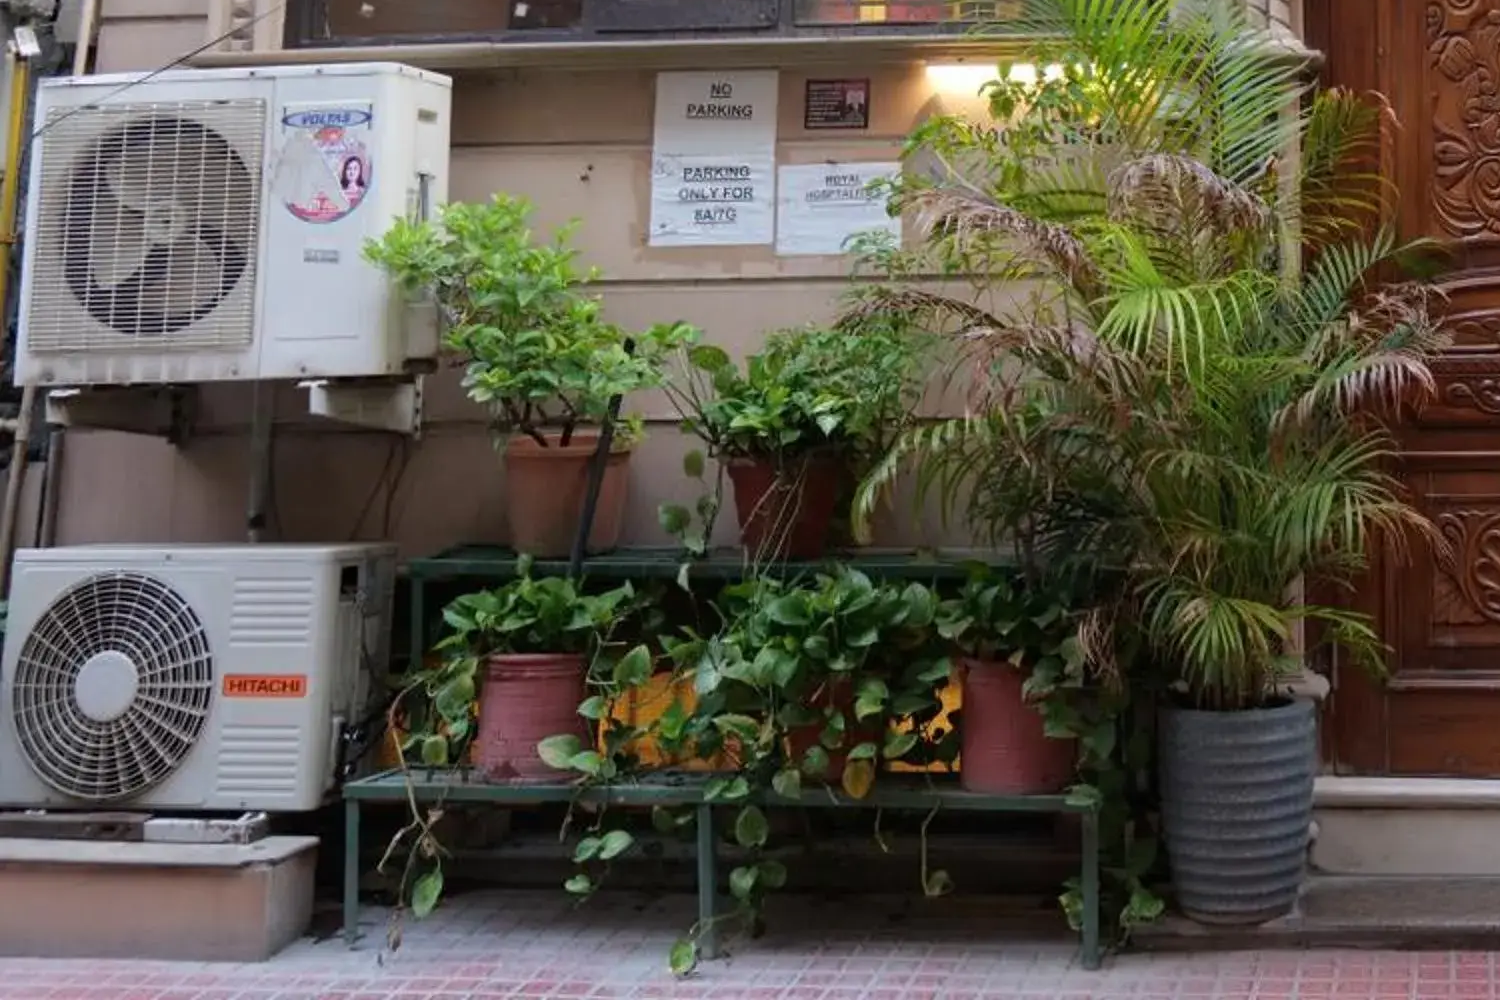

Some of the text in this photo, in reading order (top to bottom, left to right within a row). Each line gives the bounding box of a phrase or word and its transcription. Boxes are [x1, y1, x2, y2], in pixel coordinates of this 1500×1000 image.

[711, 82, 733, 96] NO
[687, 103, 753, 118] PARKING
[683, 165, 751, 181] PARKING
[825, 174, 863, 187] ROYAL
[679, 187, 754, 200] ONLY FOR
[229, 679, 300, 693] HITACHI
